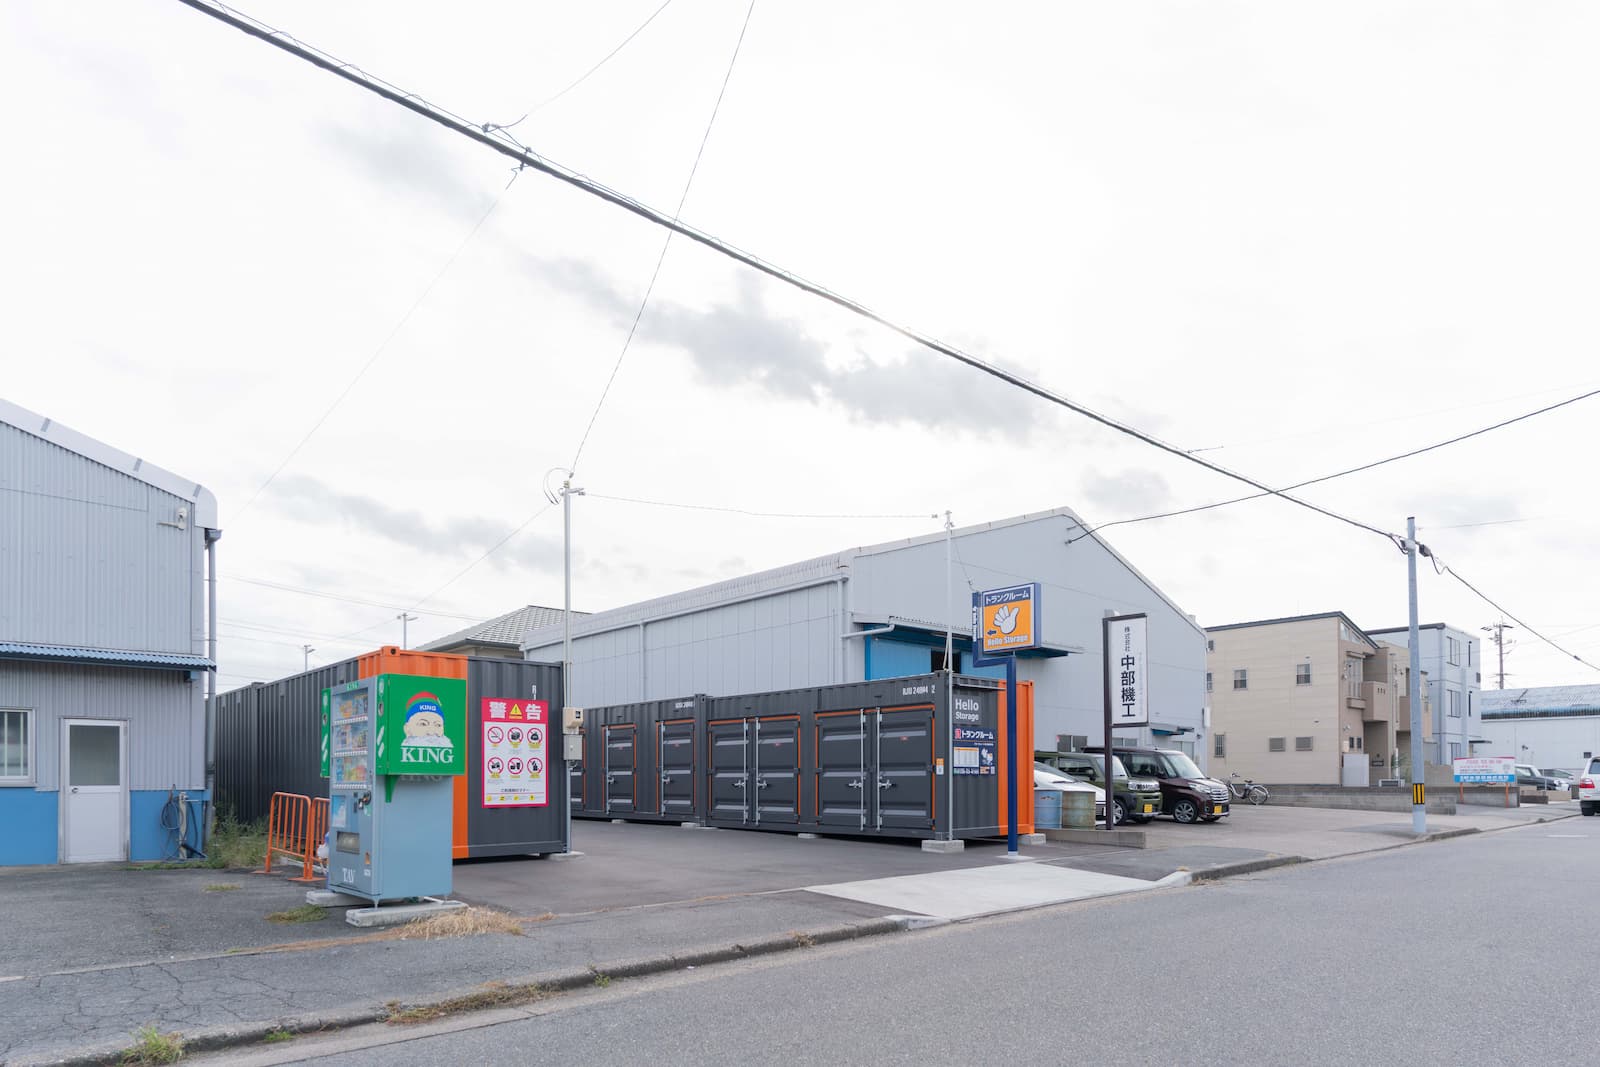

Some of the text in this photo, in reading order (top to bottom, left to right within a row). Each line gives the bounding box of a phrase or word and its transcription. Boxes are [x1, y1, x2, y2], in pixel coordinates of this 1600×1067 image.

[986, 590, 1029, 604] トランクルーム
[1121, 655, 1136, 718] 中部機工
[955, 699, 979, 711] Hello
[955, 711, 979, 722] Storage
[961, 730, 994, 740] トランクルーム
[400, 747, 454, 763] KING
